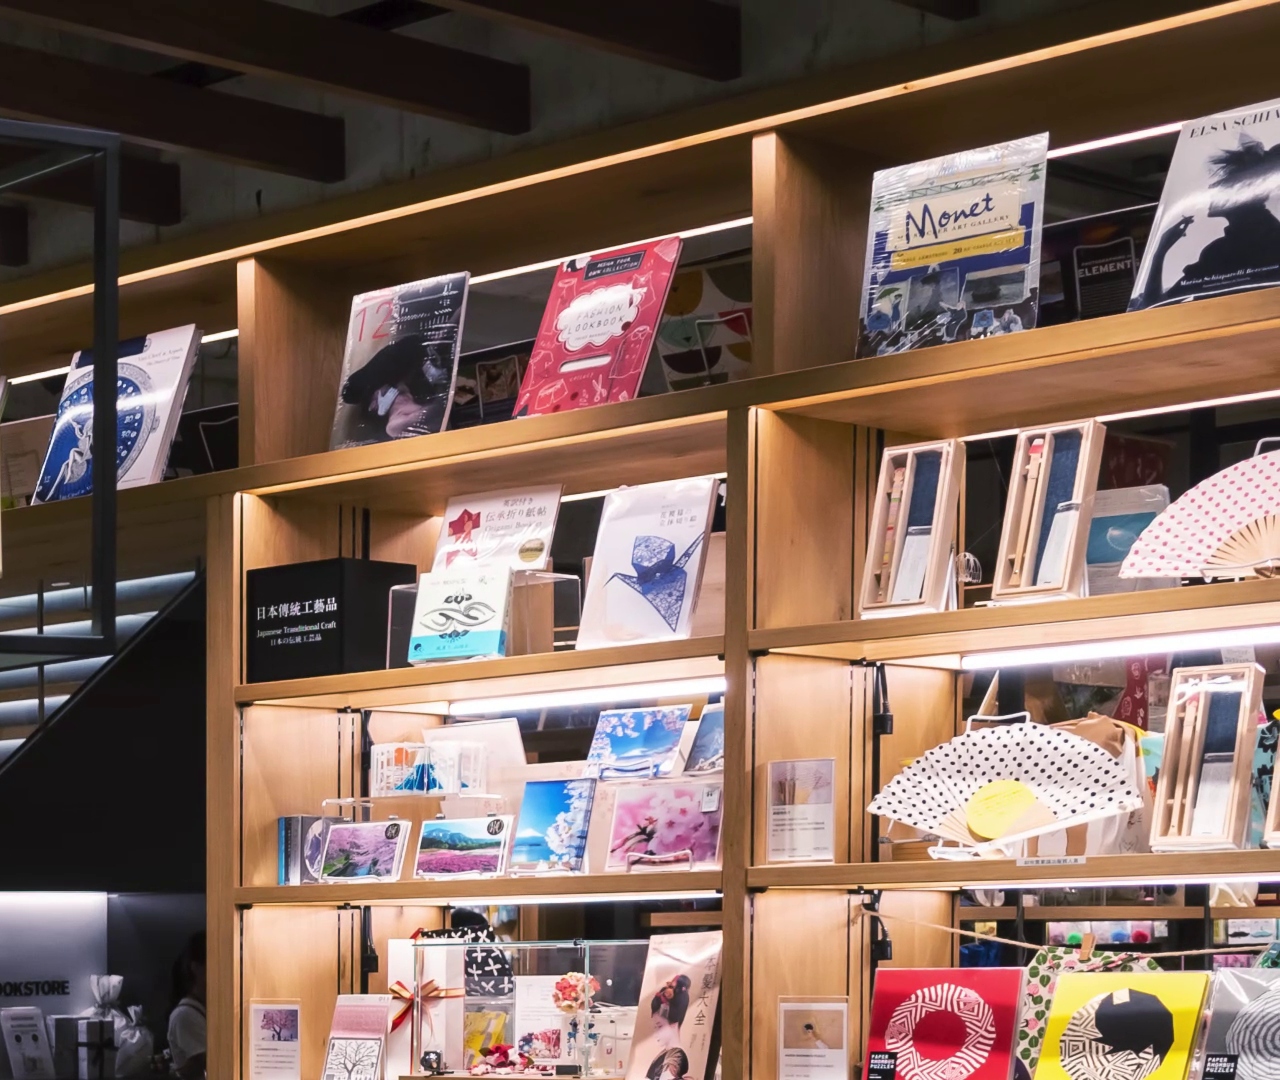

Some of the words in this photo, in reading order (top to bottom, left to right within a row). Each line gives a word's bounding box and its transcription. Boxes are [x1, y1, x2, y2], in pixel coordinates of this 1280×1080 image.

[1189, 122, 1227, 138] ELSA
[906, 193, 995, 244] Monet
[952, 223, 967, 231] ART
[970, 214, 1009, 227] GALLERY
[616, 257, 631, 265] YOUR
[576, 303, 624, 321] FASHION
[567, 314, 626, 335] LOOKBOOK
[256, 597, 337, 621] 日本傳統工藝品
[257, 628, 282, 638] Japanese
[320, 621, 336, 630] Craft
